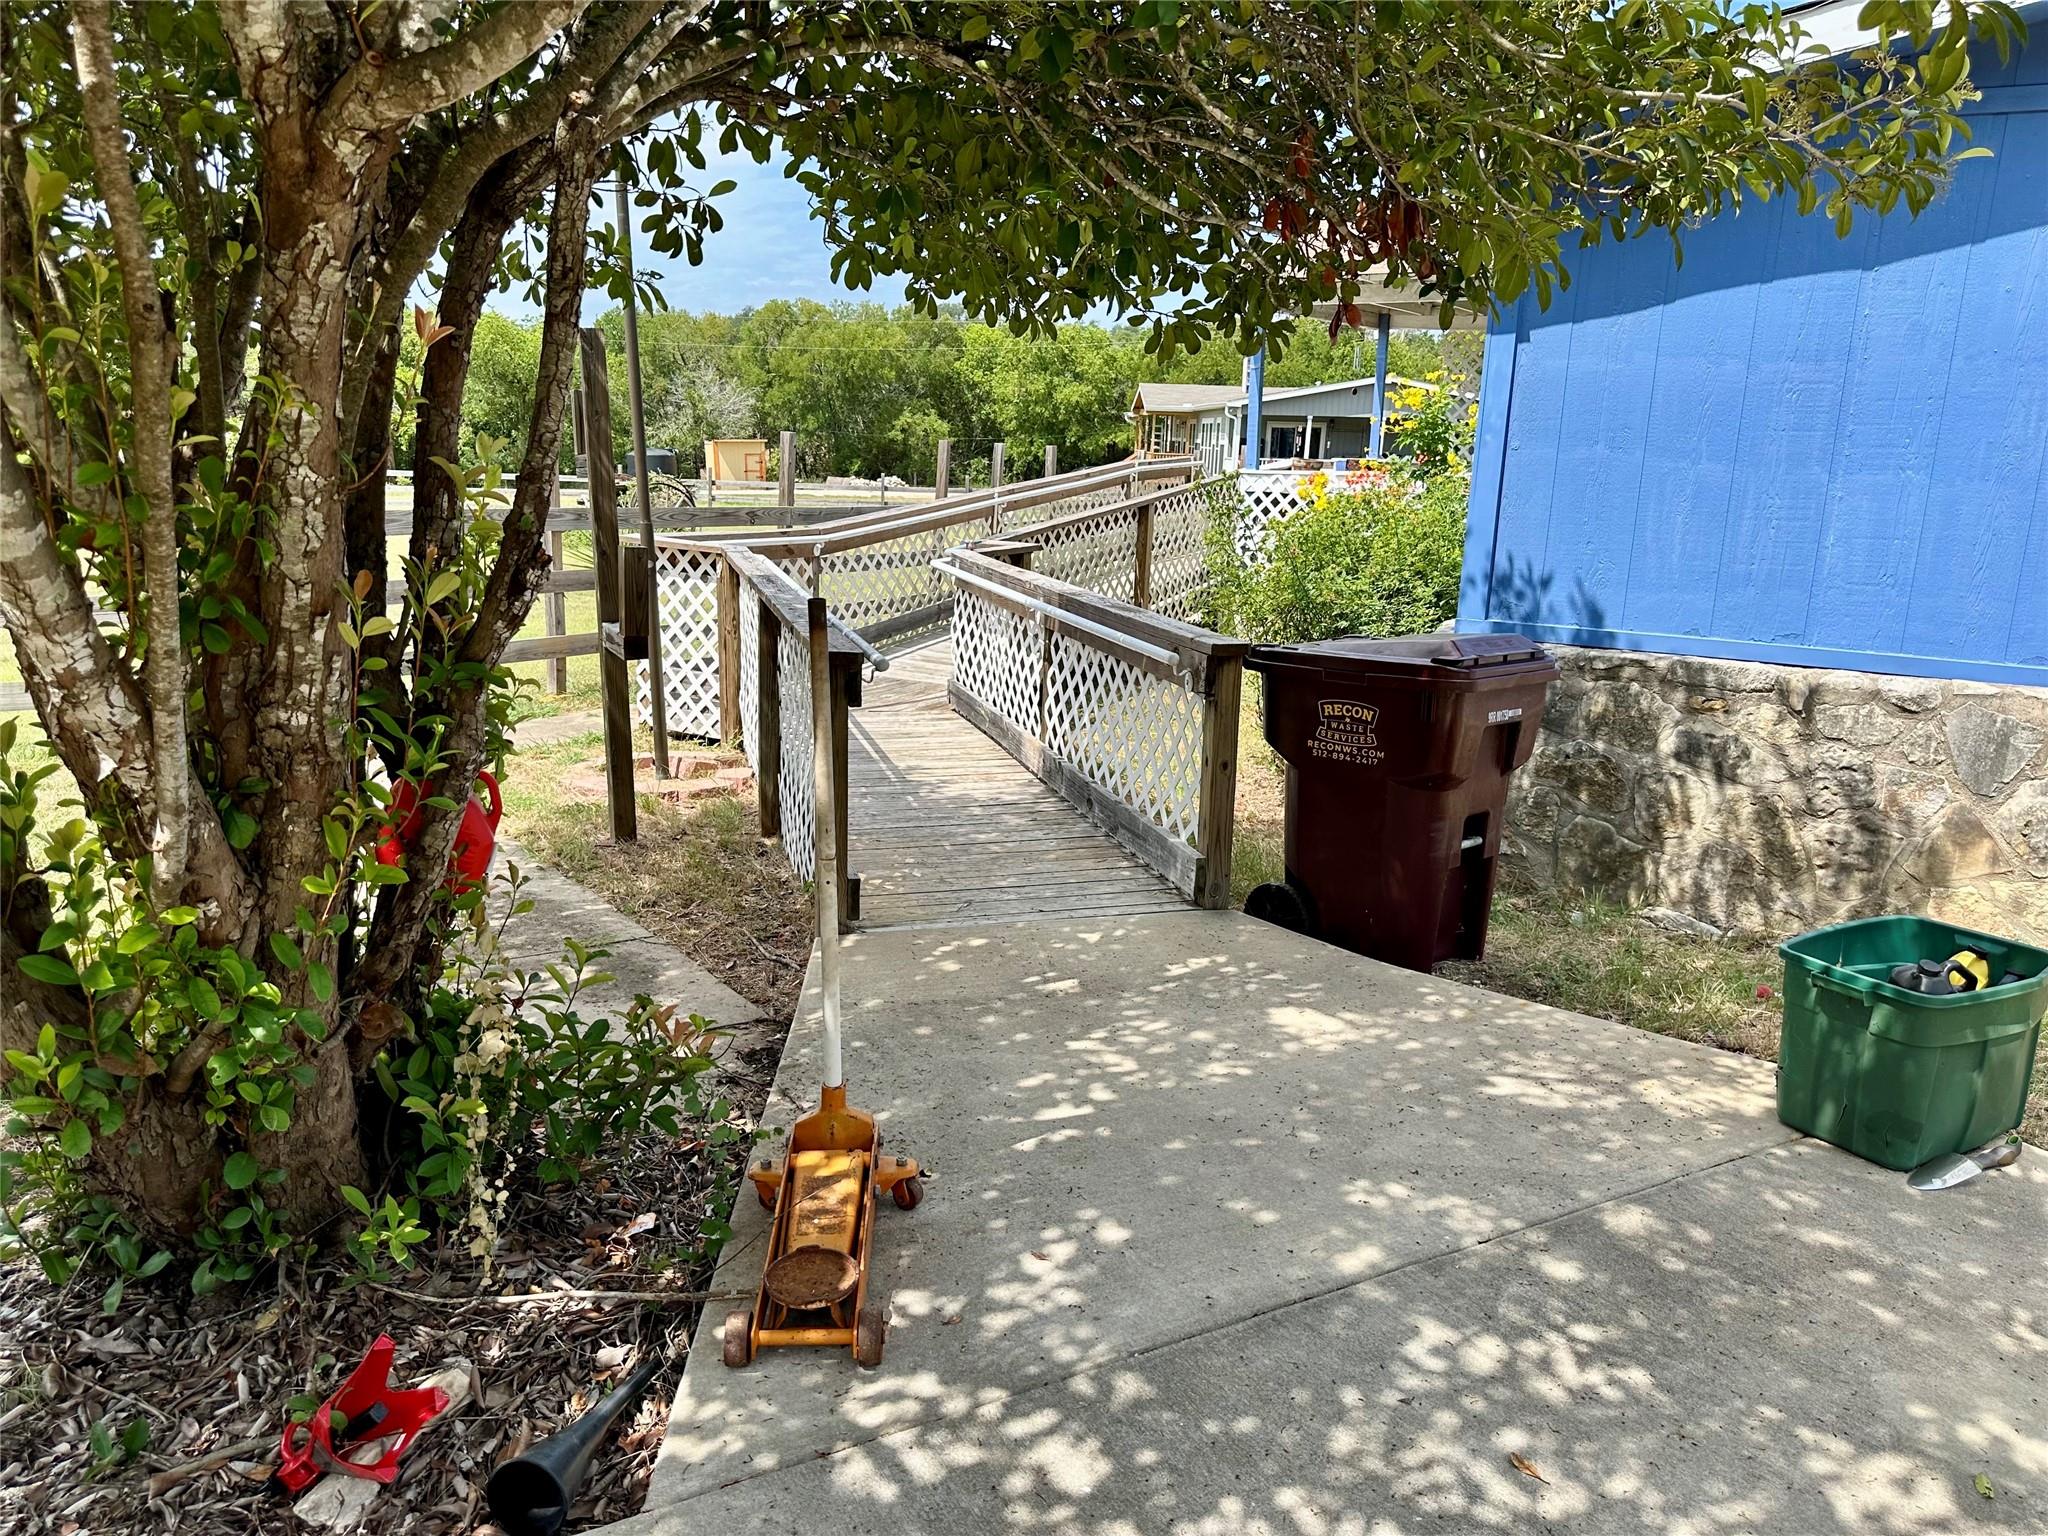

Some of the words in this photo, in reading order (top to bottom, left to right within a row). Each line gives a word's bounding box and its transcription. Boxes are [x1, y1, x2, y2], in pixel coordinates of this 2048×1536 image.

[1323, 704, 1374, 721] RECON
[1330, 721, 1364, 732] WASTE
[1320, 730, 1372, 743] SERVICES
[1307, 740, 1384, 759] RECONWS.COM
[1312, 748, 1378, 765] 512-894-2417
